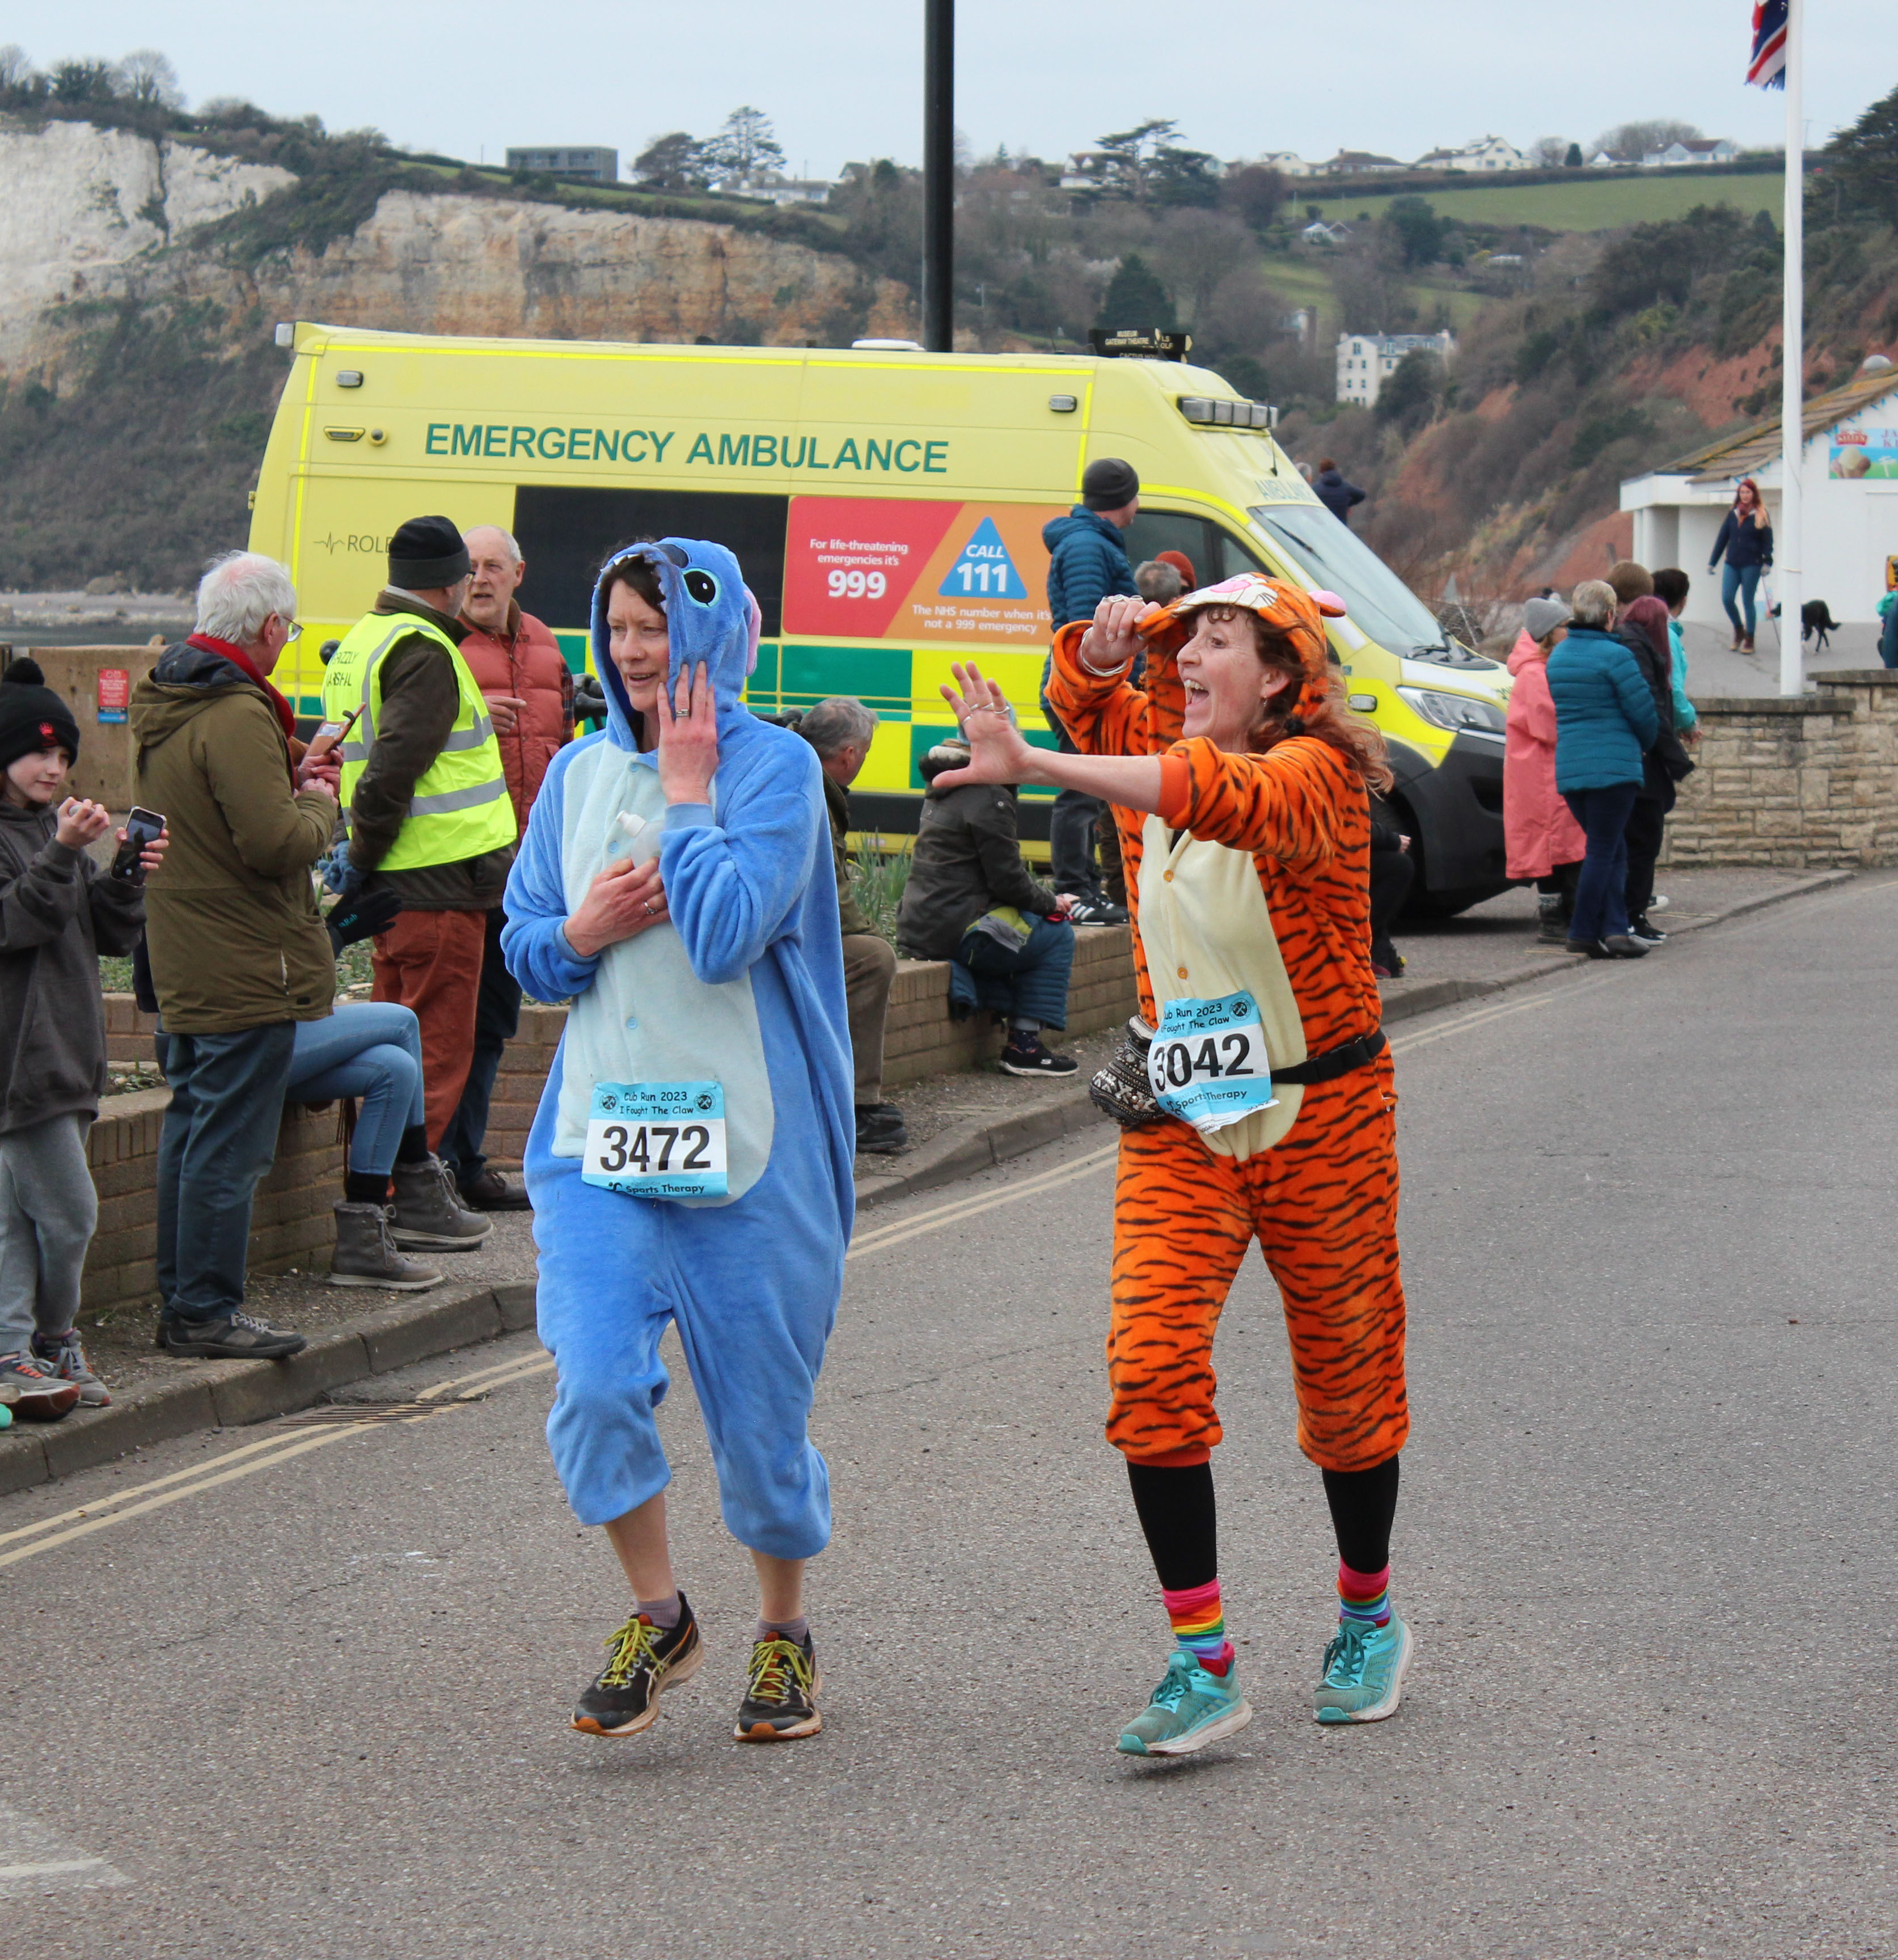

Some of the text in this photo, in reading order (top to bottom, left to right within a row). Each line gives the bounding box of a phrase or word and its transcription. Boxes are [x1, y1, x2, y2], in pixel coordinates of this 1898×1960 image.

[425, 423, 949, 472] EMERGENCY AMBULANCE
[810, 538, 909, 555] For life-threatening
[965, 544, 1004, 559] CALL
[817, 554, 899, 566] emergencies it's
[827, 569, 886, 599] 999
[957, 562, 1008, 593] 111
[912, 604, 932, 615] The
[935, 605, 957, 616] NHS
[959, 606, 1001, 619] number
[1004, 608, 1033, 620] when
[924, 619, 942, 628] not
[956, 619, 975, 630] 999
[978, 622, 1037, 635] emergency
[1164, 1003, 1222, 1020] ub Run 2023
[1208, 1016, 1230, 1027] Claw
[1153, 1033, 1254, 1092] 3042
[624, 1092, 687, 1101] Cub Run 2023
[1206, 1090, 1248, 1102] Therapy
[626, 1106, 648, 1116] Fought
[600, 1125, 711, 1172] 3472
[662, 1184, 705, 1194] Therapy
